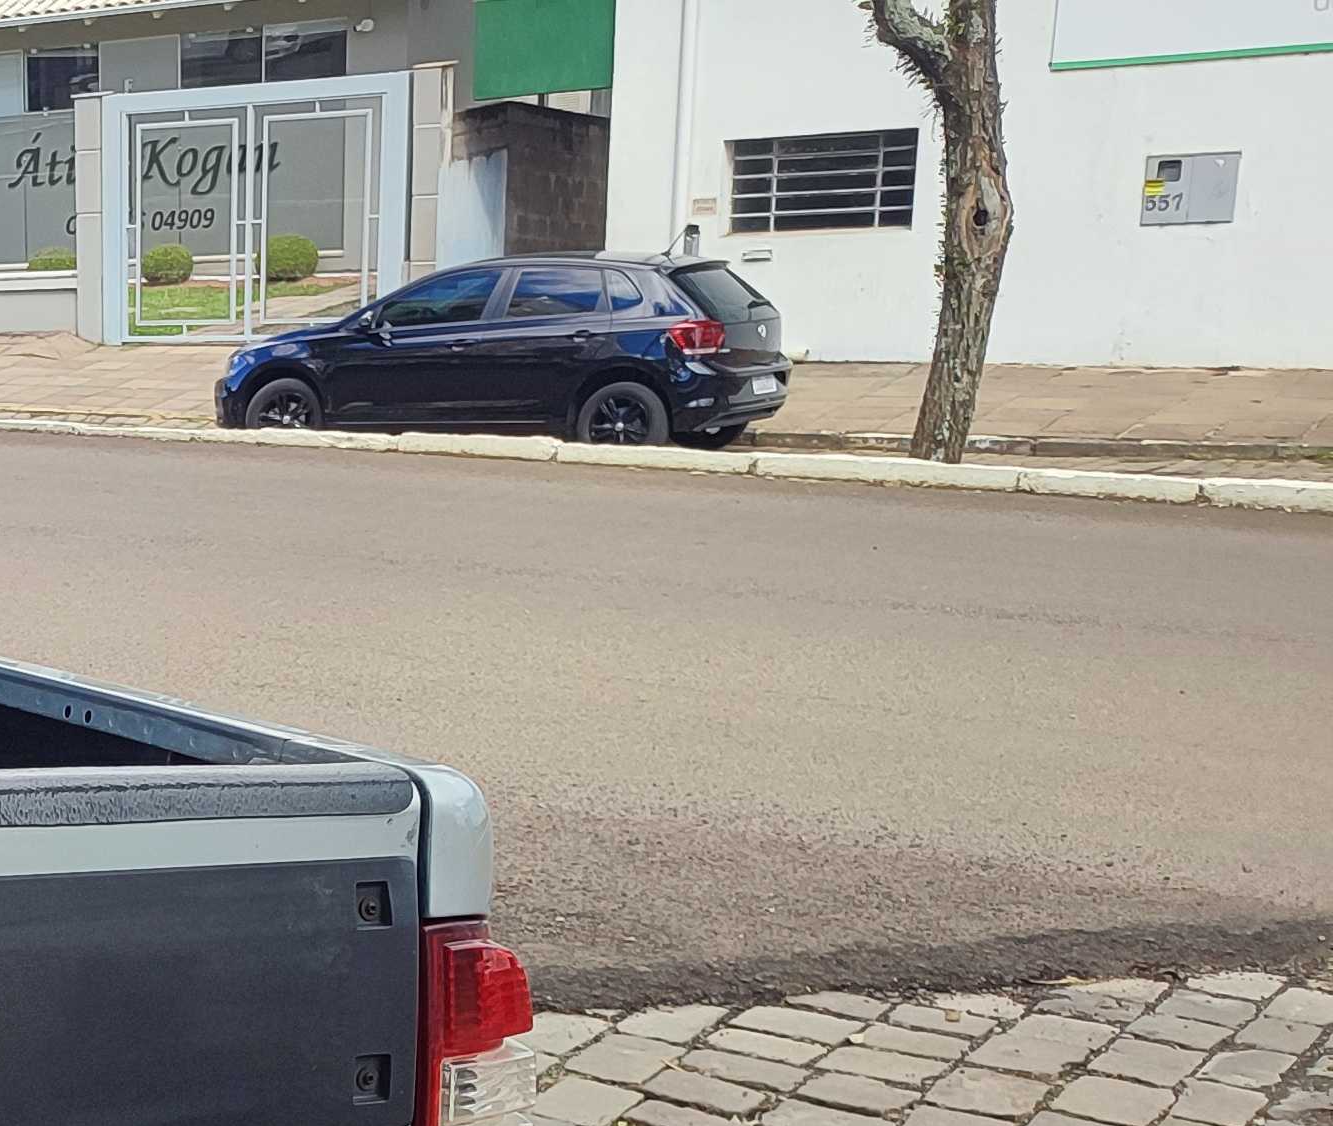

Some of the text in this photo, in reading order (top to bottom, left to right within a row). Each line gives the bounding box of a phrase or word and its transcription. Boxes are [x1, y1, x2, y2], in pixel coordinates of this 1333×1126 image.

[8, 131, 282, 196] Áti Kogan
[150, 207, 216, 232] 04909
